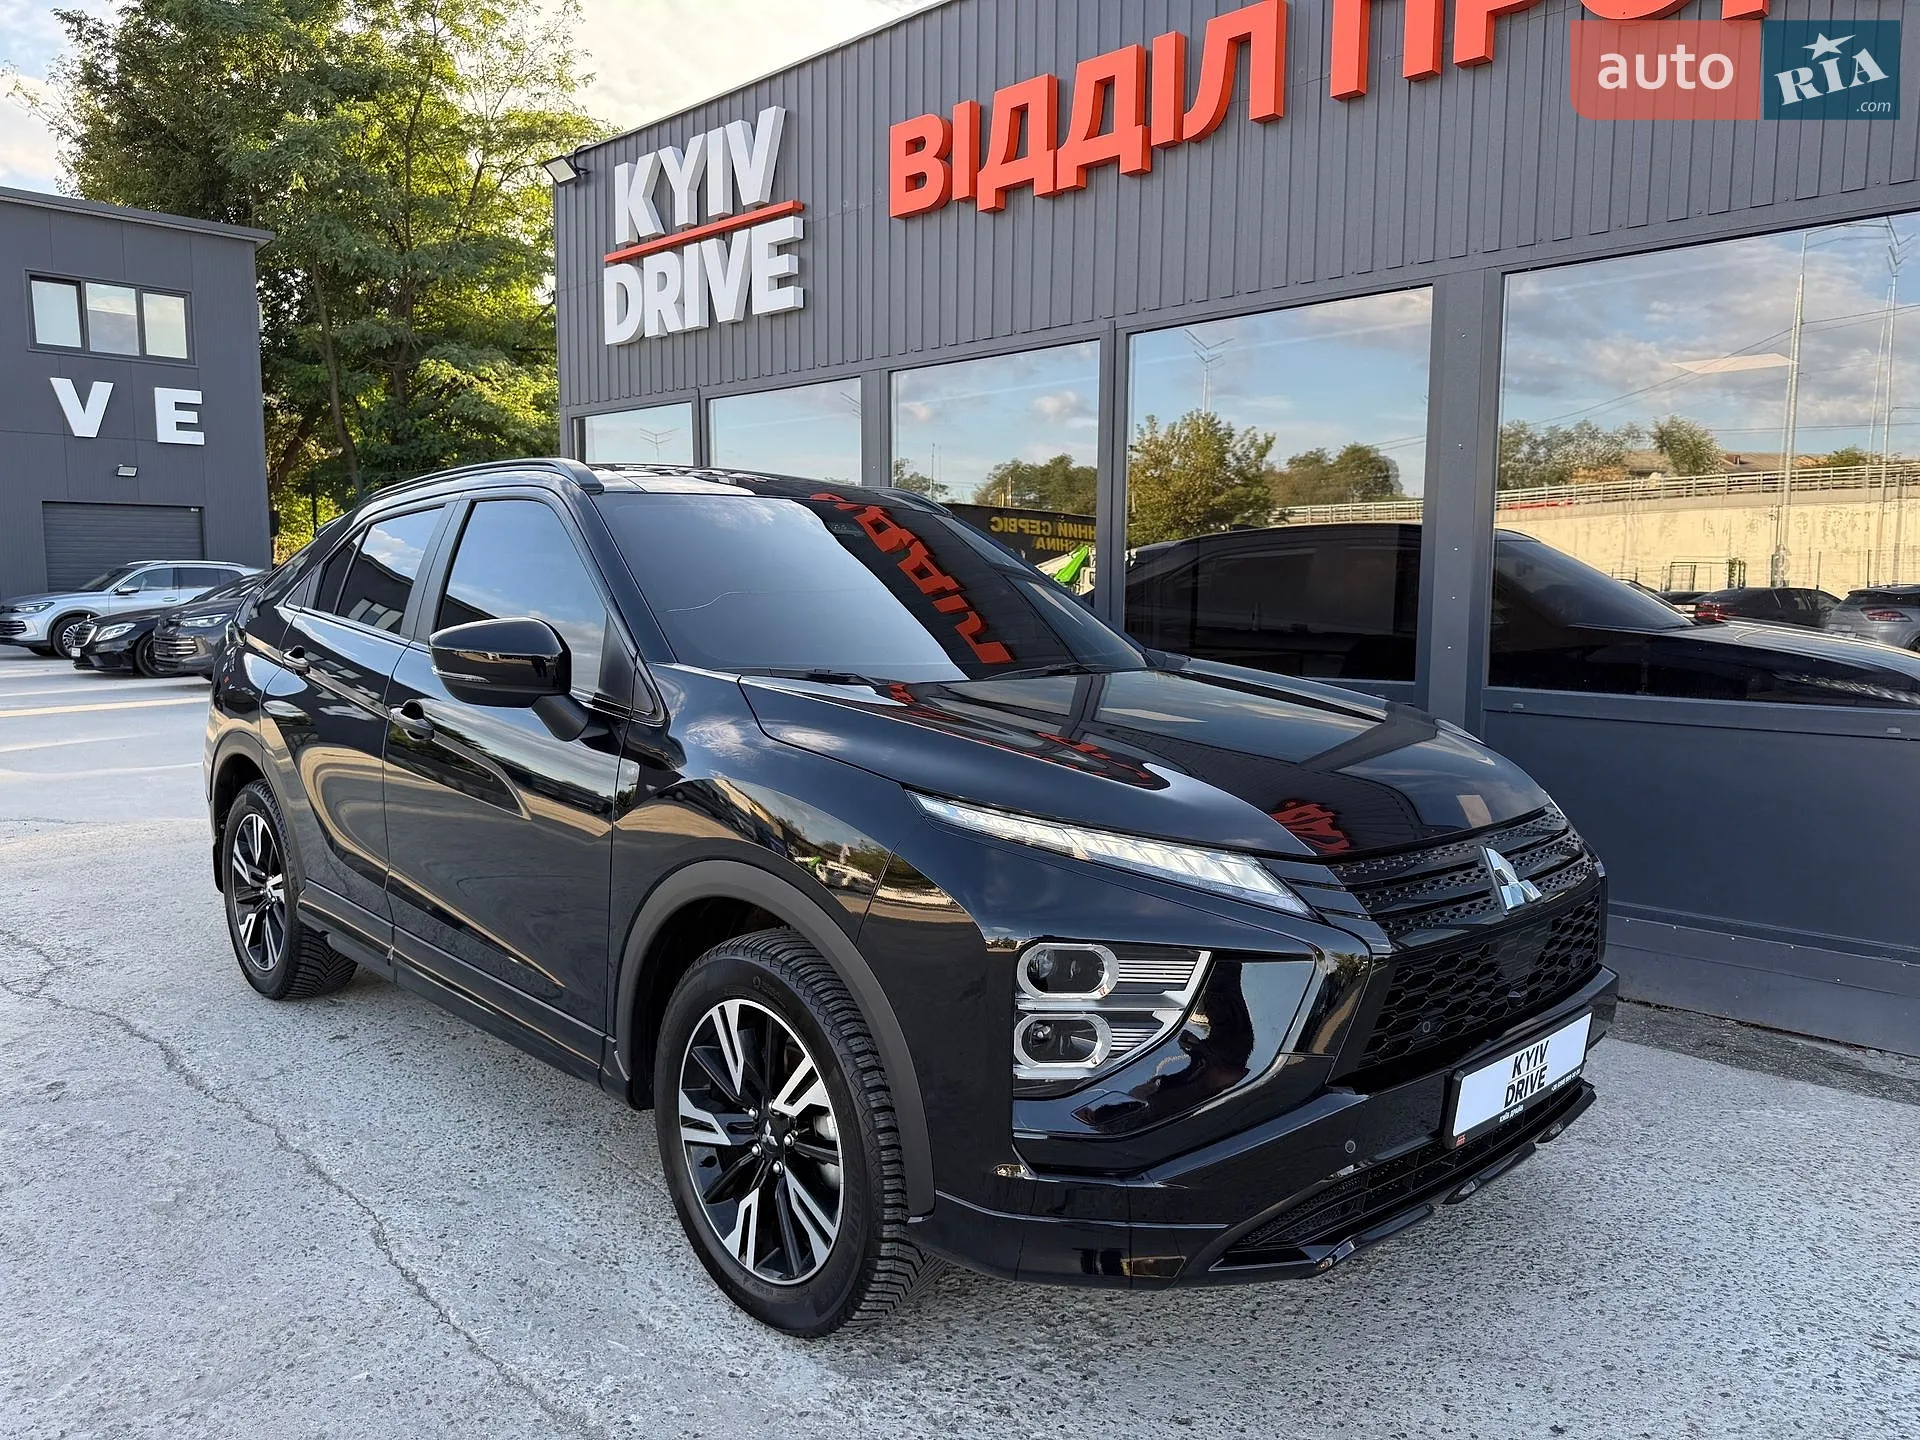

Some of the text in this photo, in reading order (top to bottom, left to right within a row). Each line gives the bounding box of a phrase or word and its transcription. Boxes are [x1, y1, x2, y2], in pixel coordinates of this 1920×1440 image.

[614, 105, 786, 245] KYIV
[889, 0, 1287, 219] ВІДДІЛ
[603, 215, 804, 346] DRIVE
[1503, 1065, 1547, 1109] DRIVE
[1511, 1039, 1549, 1079] KYIV
